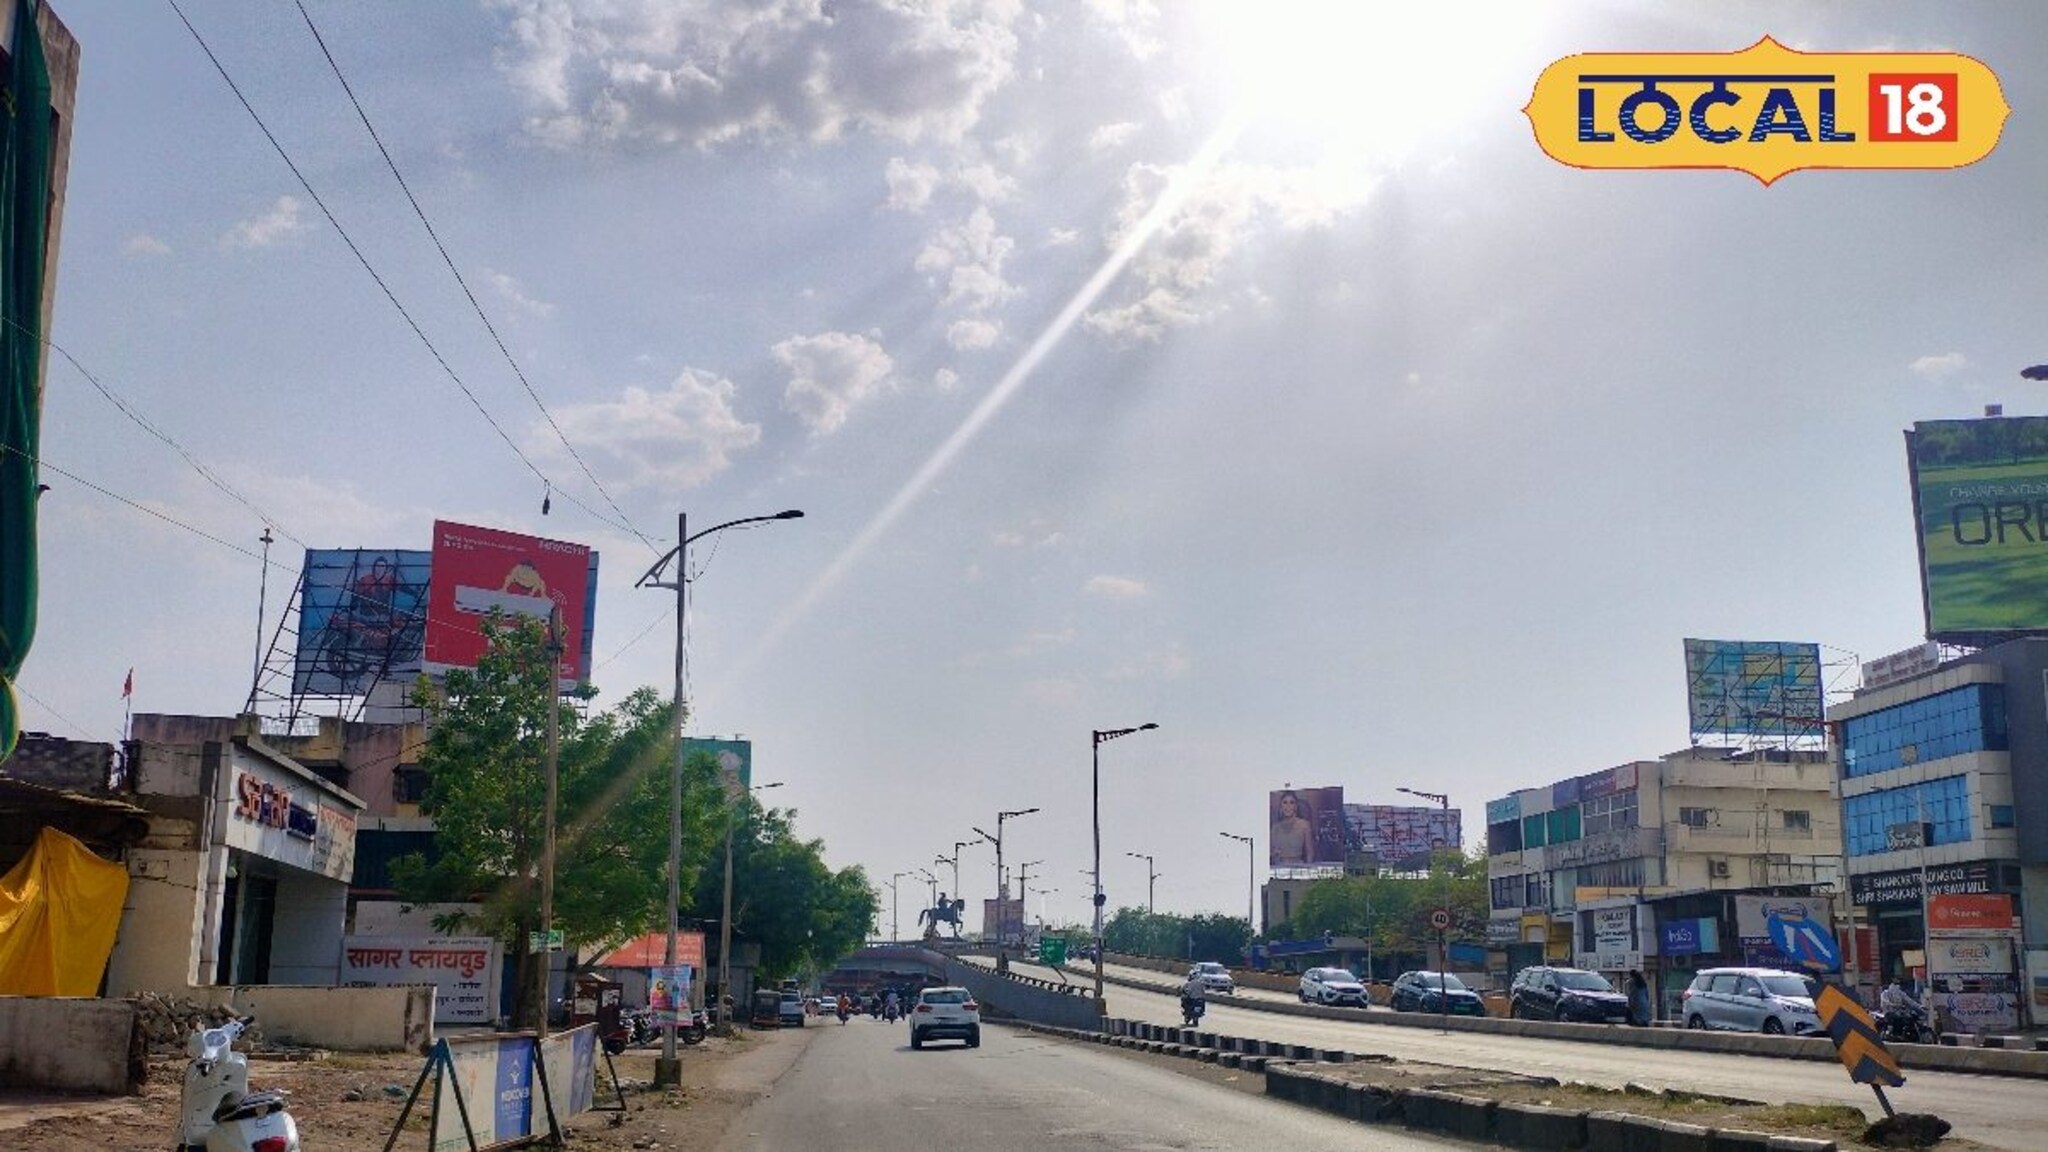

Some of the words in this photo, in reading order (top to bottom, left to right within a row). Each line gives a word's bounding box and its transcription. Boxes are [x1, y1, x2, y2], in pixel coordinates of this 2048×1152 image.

[1876, 887, 1917, 902] SHANKAR
[1434, 914, 1446, 924] 40
[346, 948, 404, 969] सागर
[408, 949, 488, 979] प्लायवुड
